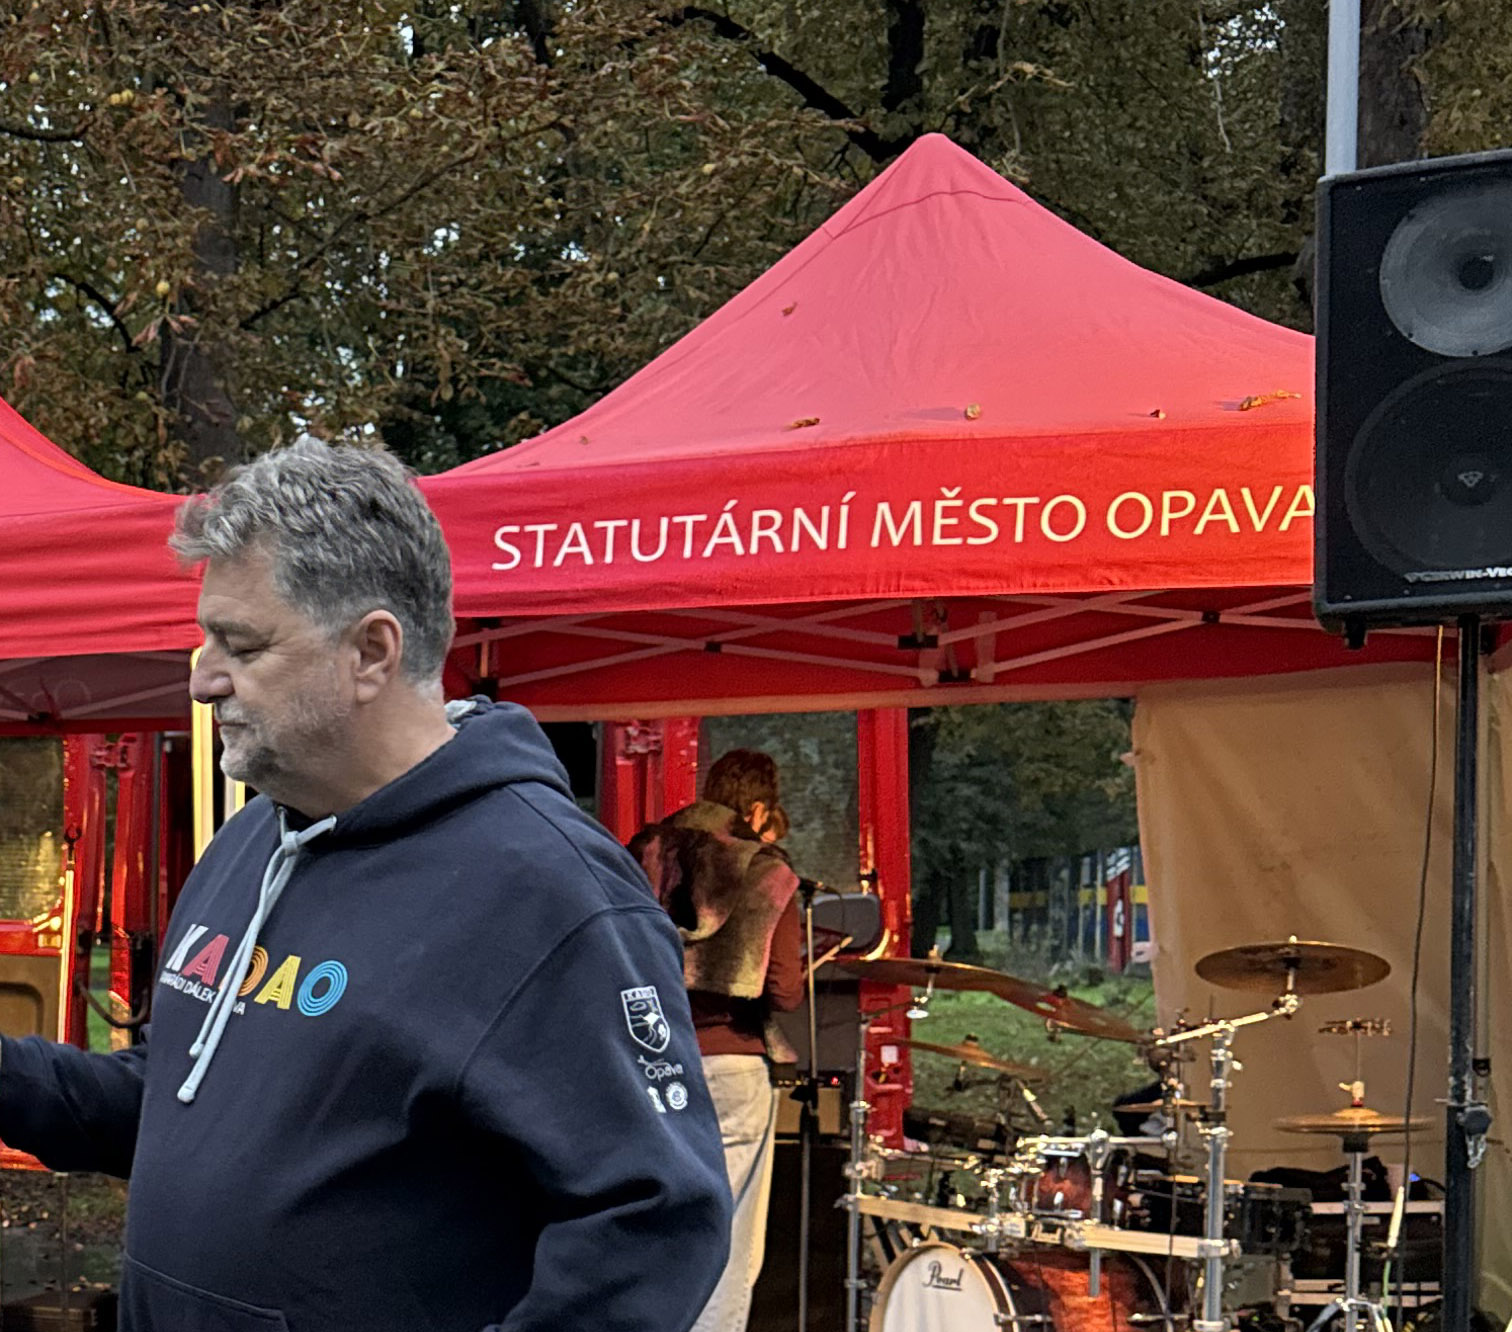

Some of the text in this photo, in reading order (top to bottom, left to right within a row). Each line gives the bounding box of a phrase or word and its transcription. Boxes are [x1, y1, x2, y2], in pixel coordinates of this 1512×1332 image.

[491, 484, 1315, 571] STATUTÁRNÍ MĚSTO OPAVA
[644, 1063, 684, 1082] Opava
[922, 1260, 964, 1286] Pearl
